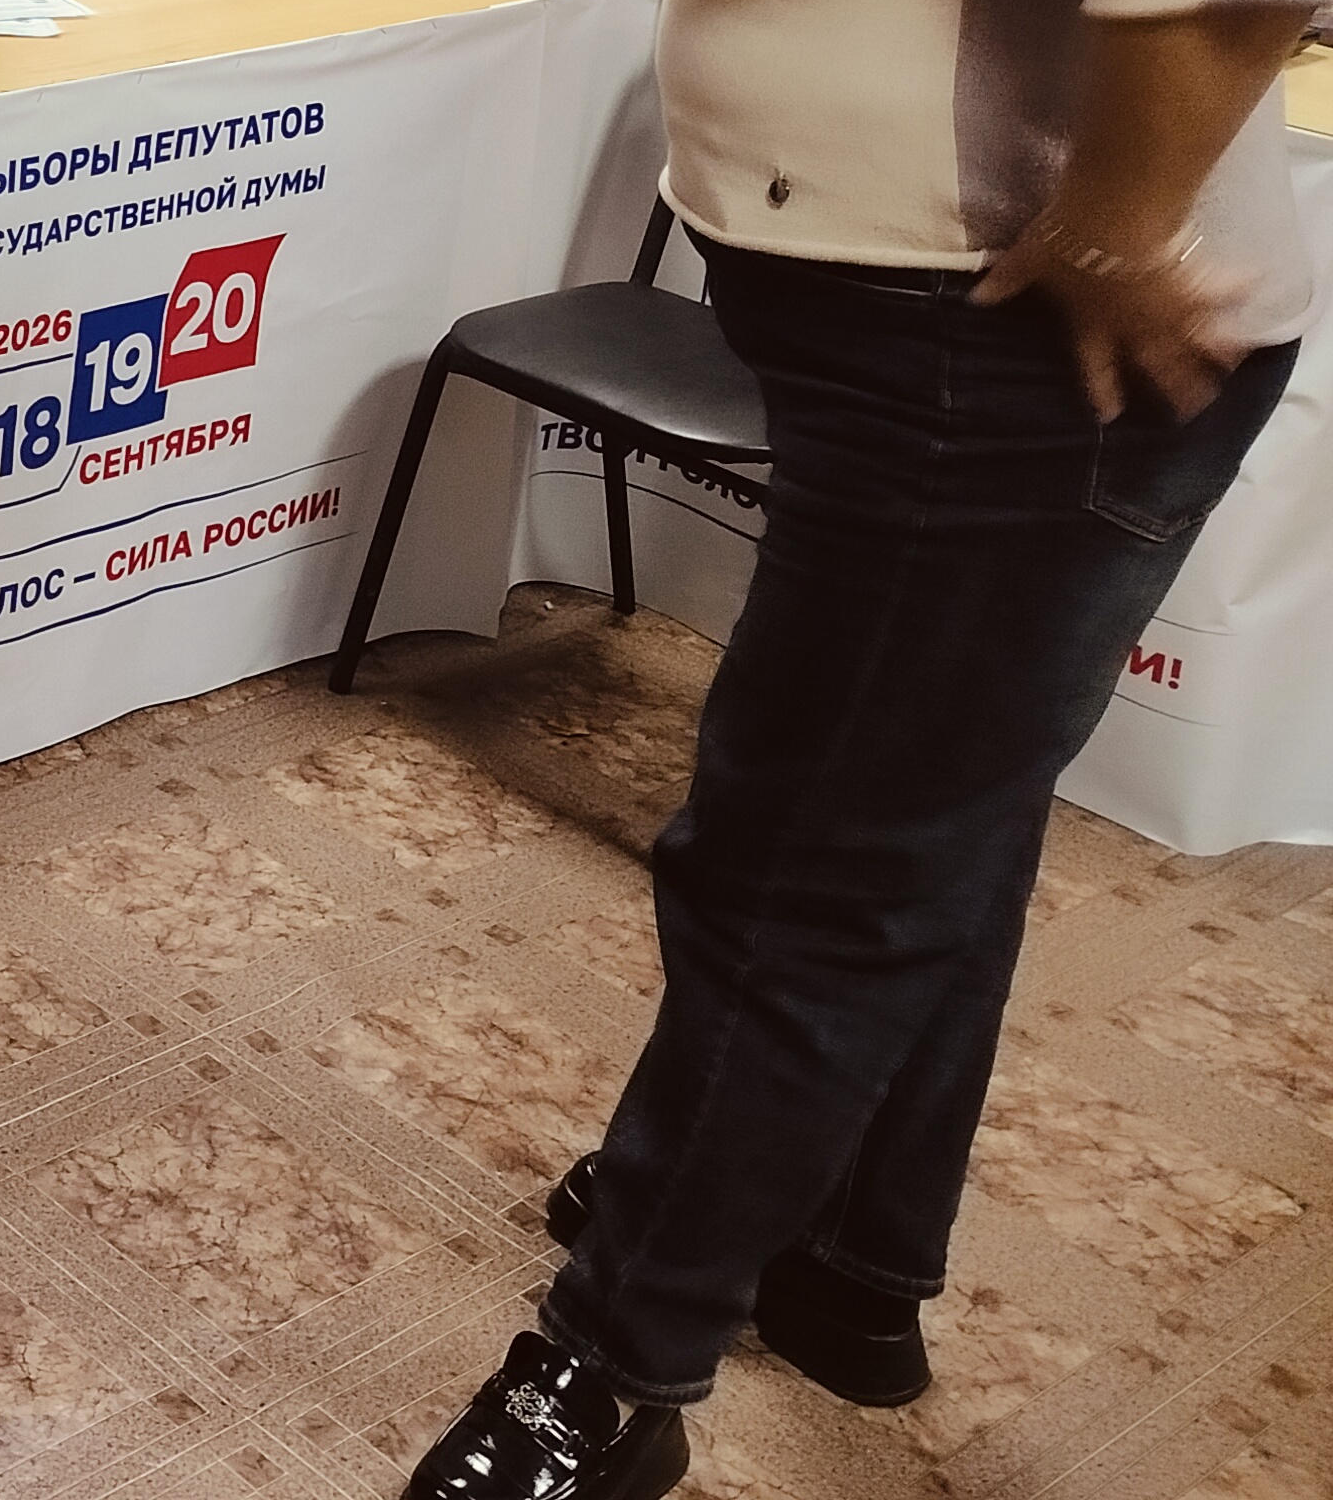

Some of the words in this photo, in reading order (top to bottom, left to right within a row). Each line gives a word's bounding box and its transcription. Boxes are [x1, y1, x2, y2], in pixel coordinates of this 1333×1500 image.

[128, 102, 325, 174] ДЕПУТАТОВ
[242, 165, 326, 210] ДУМЫ
[169, 272, 257, 356] 20
[83, 332, 154, 412] 19
[79, 414, 252, 485] СЕНТЯБРЯ
[105, 531, 193, 582] СИЛА
[203, 487, 341, 554] РОССИИ!
